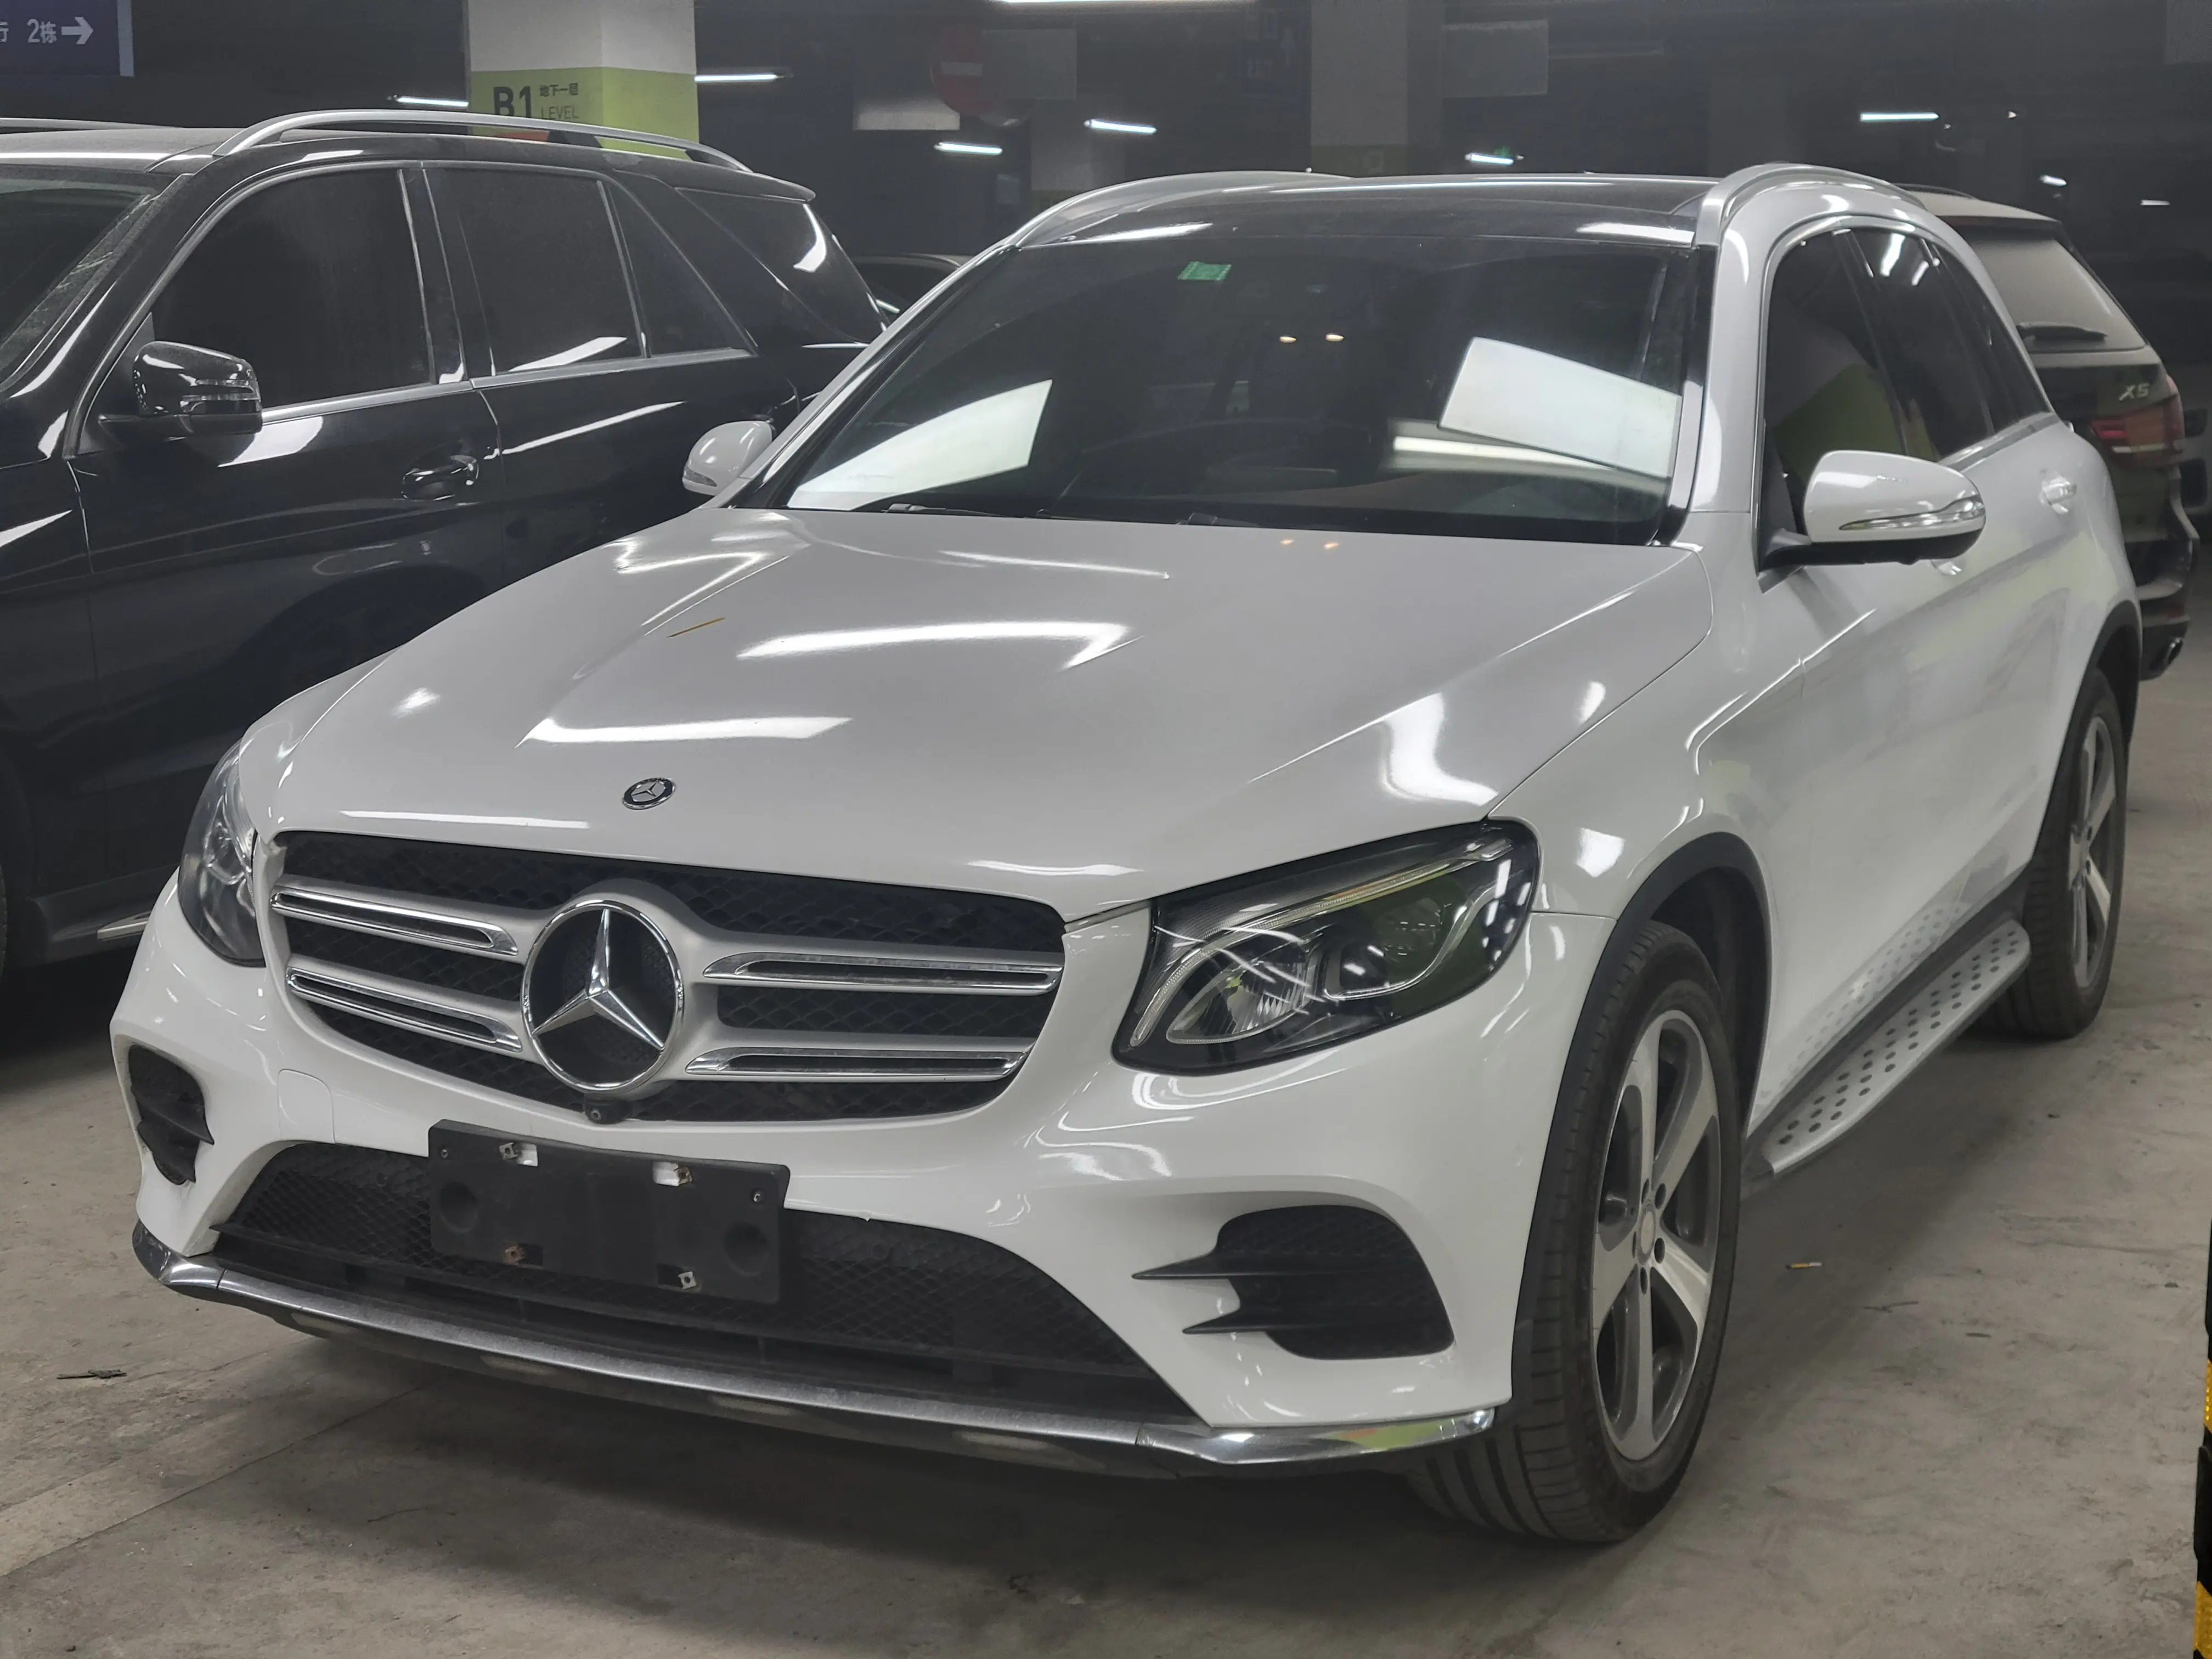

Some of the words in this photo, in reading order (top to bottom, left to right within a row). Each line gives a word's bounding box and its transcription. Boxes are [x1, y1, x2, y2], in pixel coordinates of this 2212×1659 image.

[27, 19, 57, 43] 2栋
[493, 86, 531, 117] B1
[540, 105, 579, 120] LEVEL
[2118, 382, 2149, 401] X5
